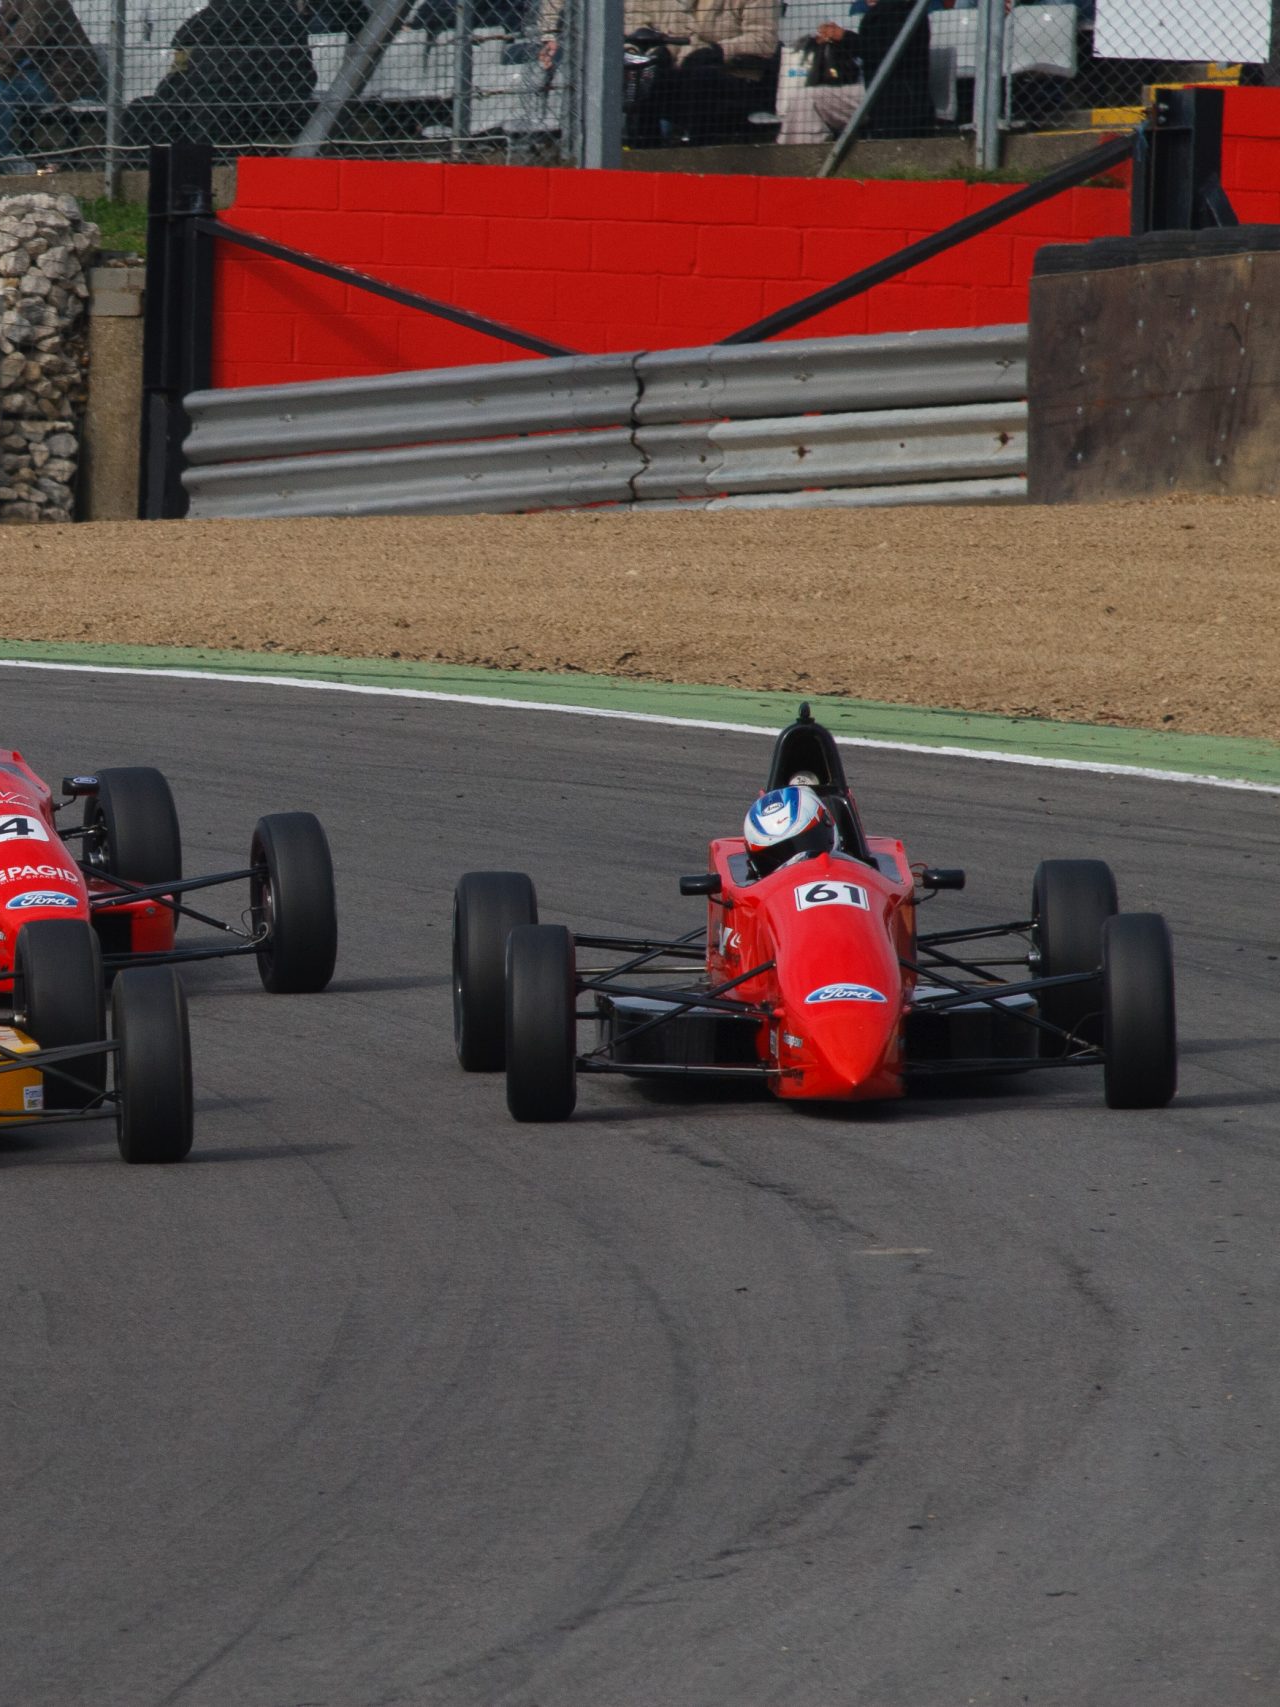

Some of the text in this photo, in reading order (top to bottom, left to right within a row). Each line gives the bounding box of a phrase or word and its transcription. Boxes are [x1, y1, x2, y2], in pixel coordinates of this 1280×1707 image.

[7, 865, 79, 882] PAGID
[19, 893, 70, 906] Ford
[805, 884, 861, 904] 61
[818, 986, 873, 1000] Ford
